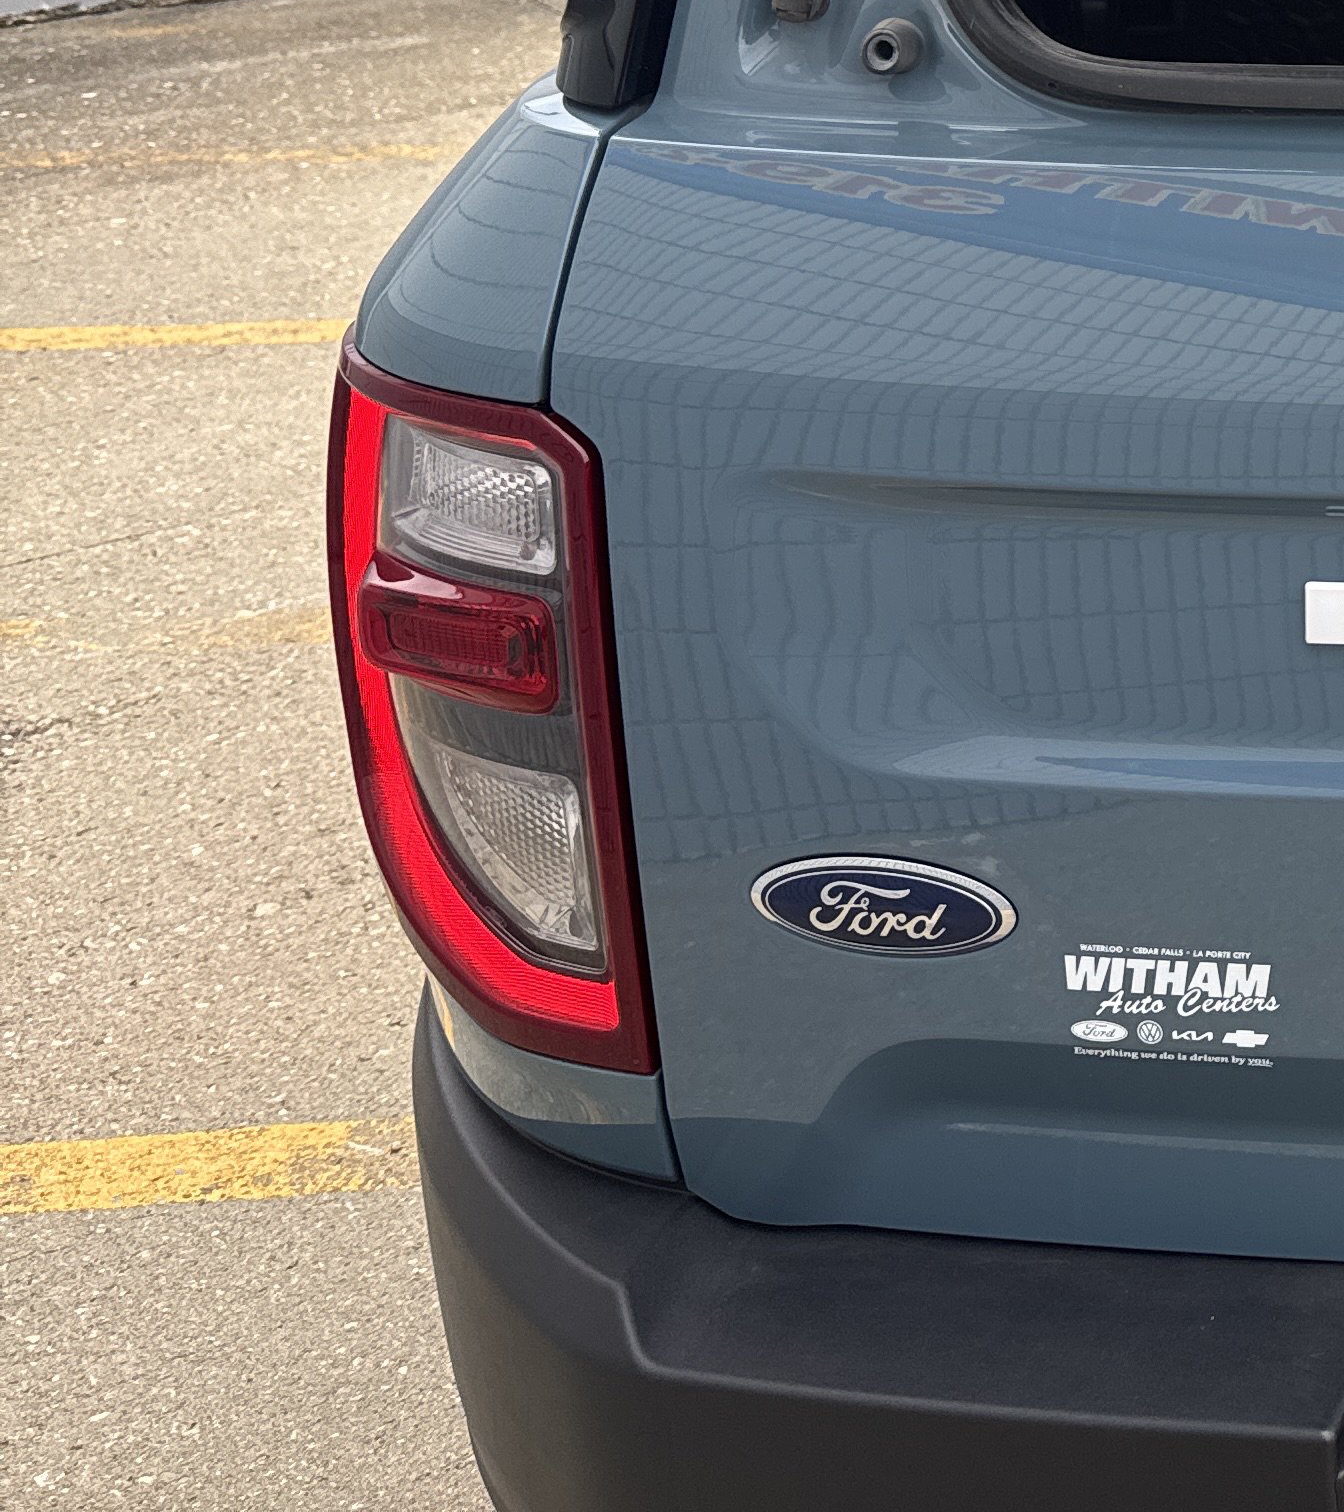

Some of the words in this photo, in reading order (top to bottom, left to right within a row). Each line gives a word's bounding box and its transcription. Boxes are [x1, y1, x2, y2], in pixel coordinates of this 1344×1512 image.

[809, 881, 948, 941] Ford
[1080, 943, 1123, 954] WATERLOO
[1133, 946, 1159, 956] CEDAR
[1161, 947, 1183, 957] FALLS
[1193, 949, 1204, 958] LA
[1206, 950, 1231, 959] PORTE
[1233, 951, 1252, 960] CITY
[1064, 954, 1271, 999] WITHAM
[1096, 990, 1166, 1016] Auto
[1177, 988, 1280, 1017] Centers
[1073, 1047, 1139, 1059] Everything
[1141, 1051, 1158, 1059] we
[1159, 1051, 1175, 1061] do
[1178, 1053, 1188, 1061] is
[1190, 1053, 1229, 1063] driven
[1231, 1055, 1246, 1066] by
